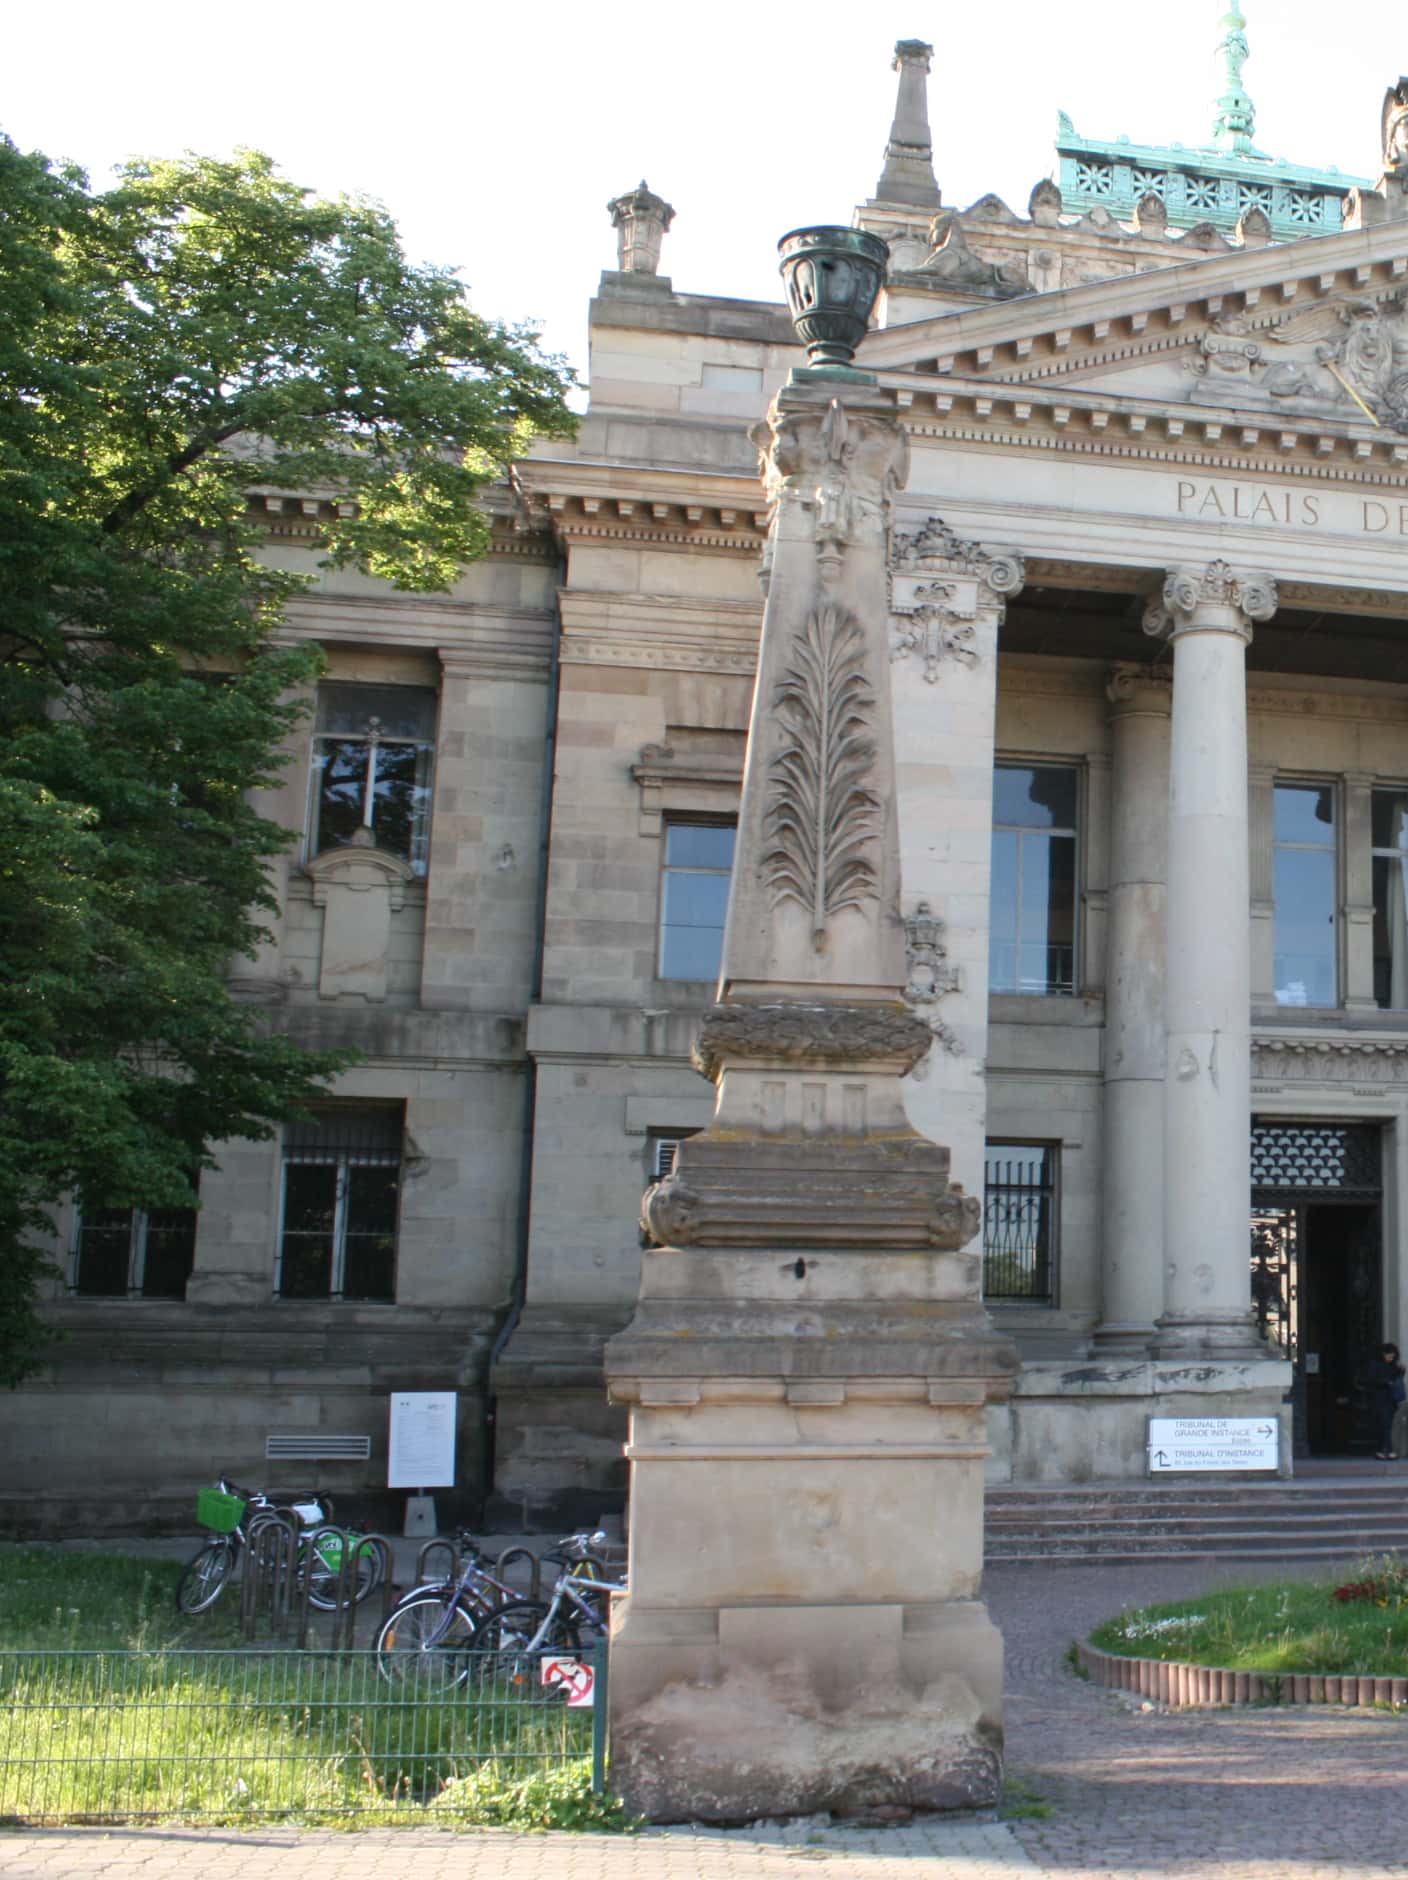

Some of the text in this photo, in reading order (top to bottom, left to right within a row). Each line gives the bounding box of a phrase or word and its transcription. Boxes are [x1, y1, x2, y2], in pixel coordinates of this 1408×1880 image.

[1176, 480, 1320, 525] PALAIS
[1175, 1421, 1227, 1429] TRIBUNAL DE
[1175, 1449, 1264, 1457] TRIBUNAL D'INSTANCE
